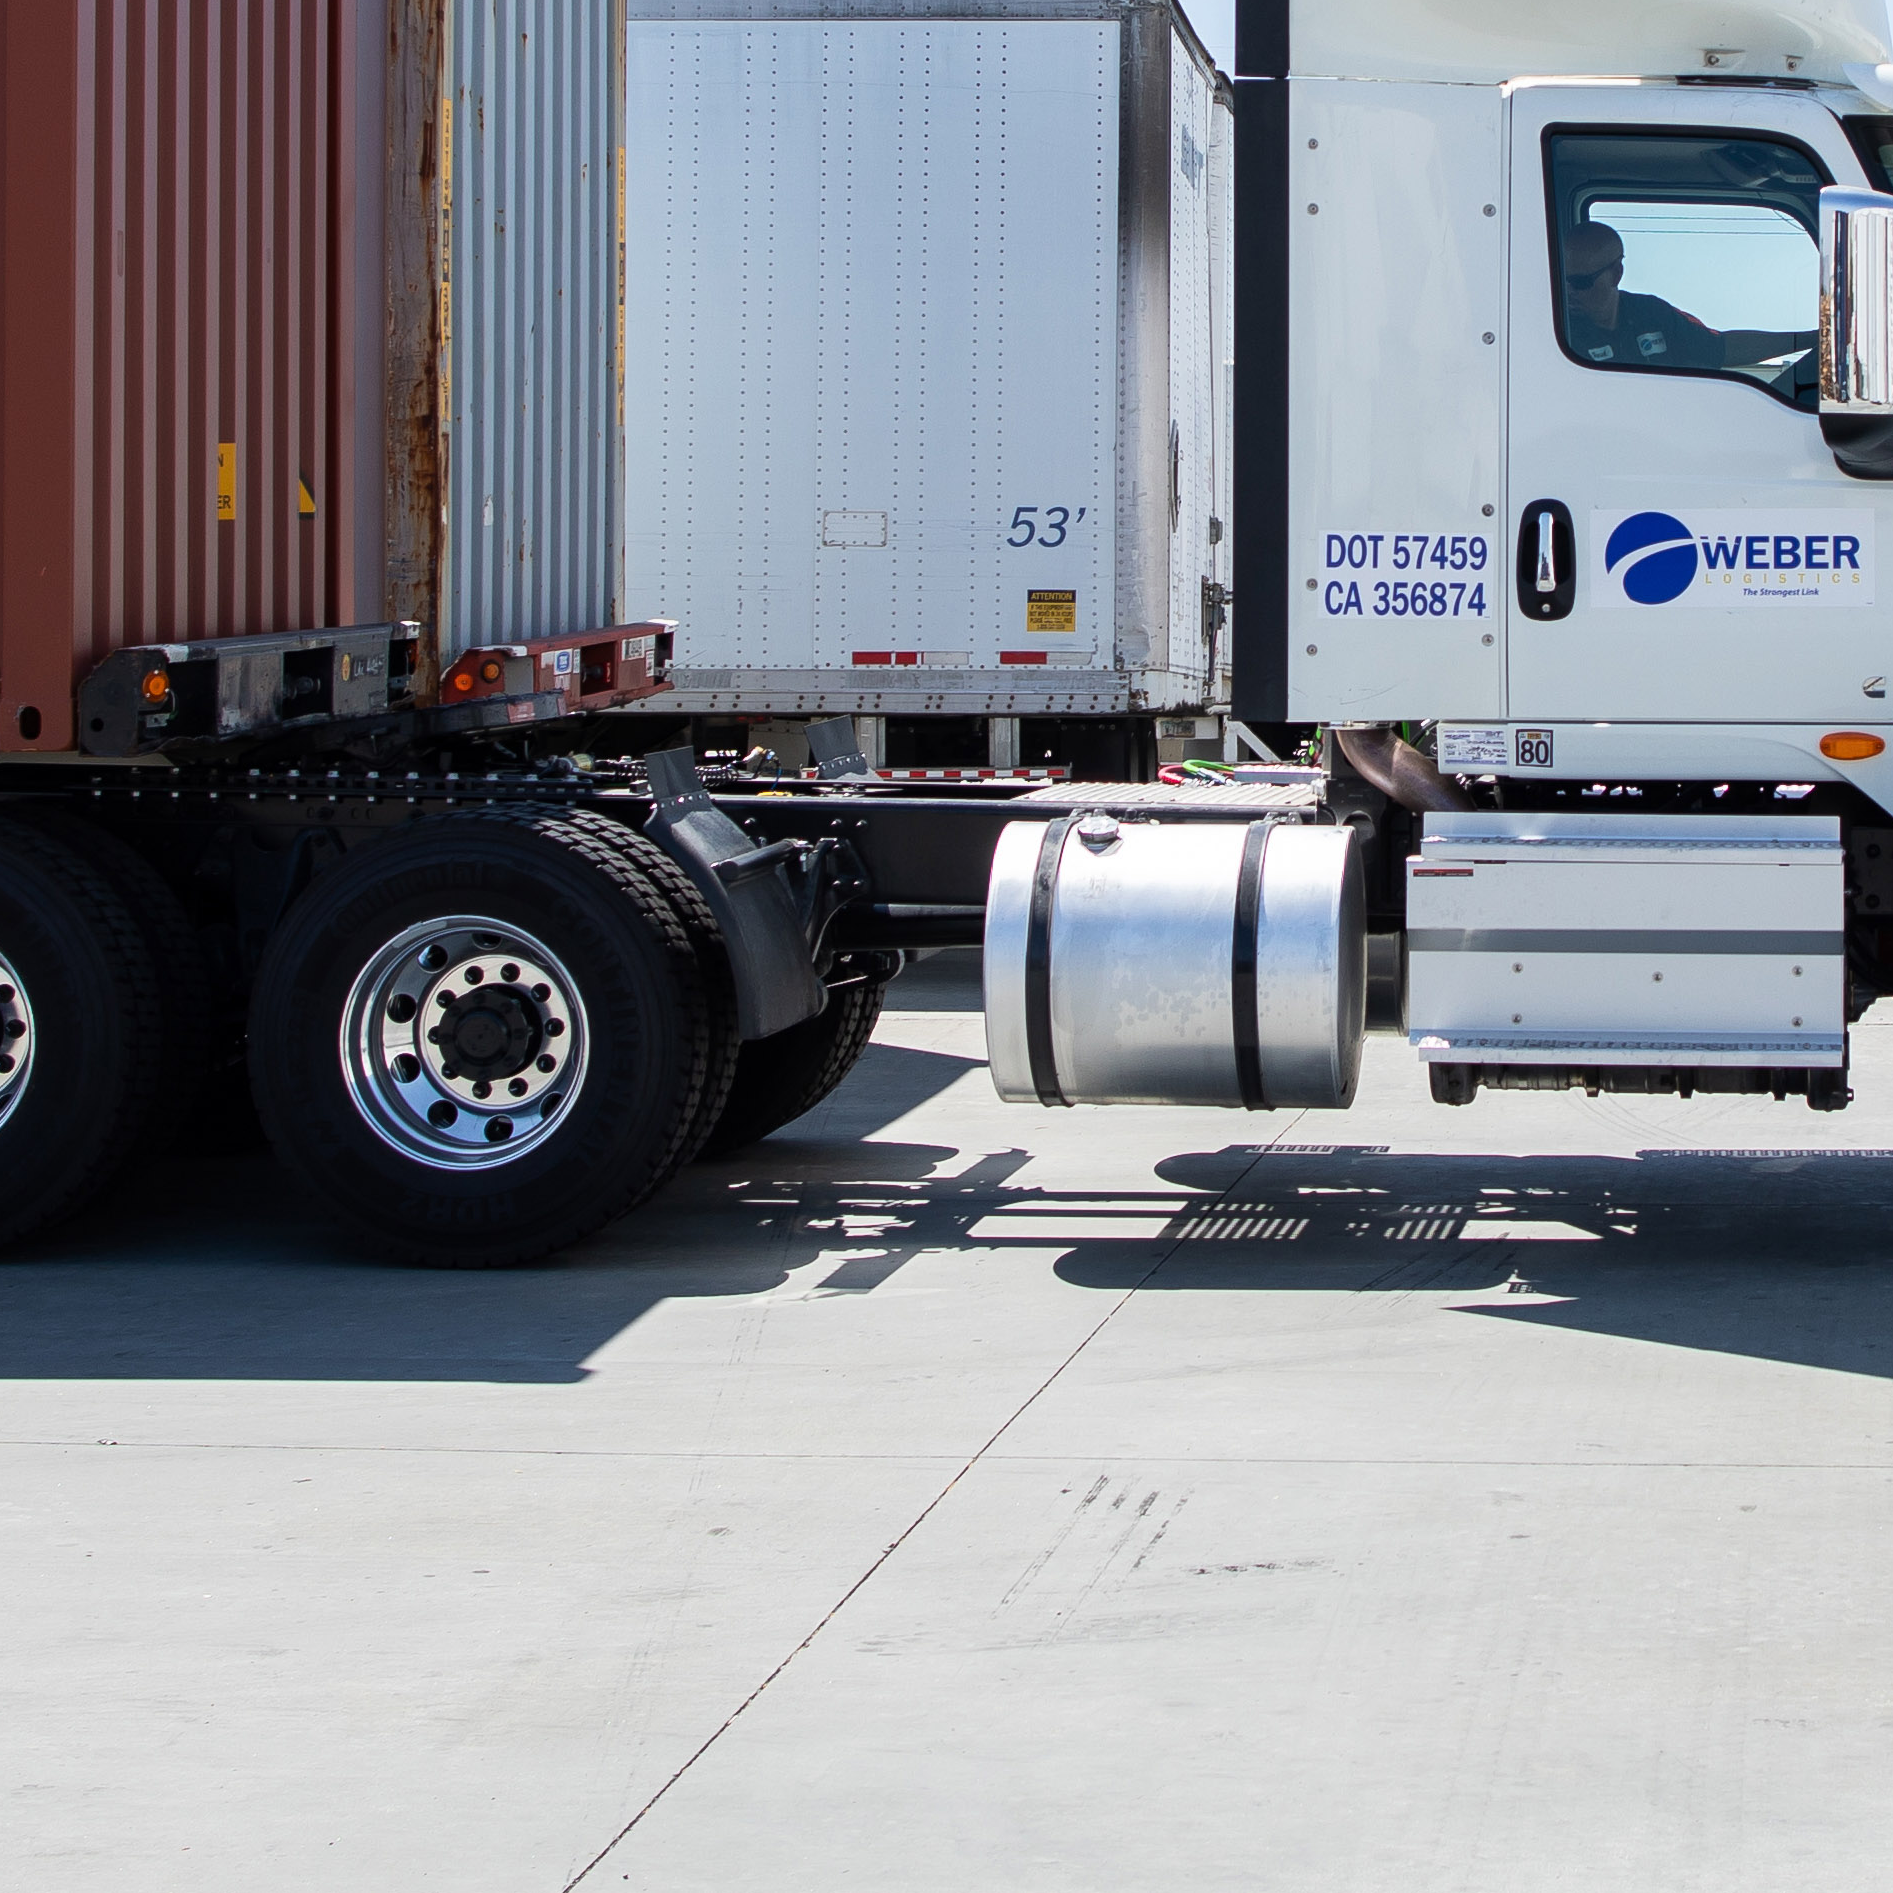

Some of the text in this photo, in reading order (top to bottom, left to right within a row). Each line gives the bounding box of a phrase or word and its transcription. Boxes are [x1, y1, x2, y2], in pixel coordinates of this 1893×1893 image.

[1006, 505, 1087, 548] 53'
[1326, 534, 1488, 571] DOT 57459
[1699, 535, 1861, 570] WEBER
[1704, 573, 1861, 584] LOGISTICS
[1742, 587, 1820, 598] The Strongest Link
[1030, 591, 1074, 601] ATTENTION
[1324, 581, 1487, 617] CA 356874
[1520, 740, 1550, 765] 80
